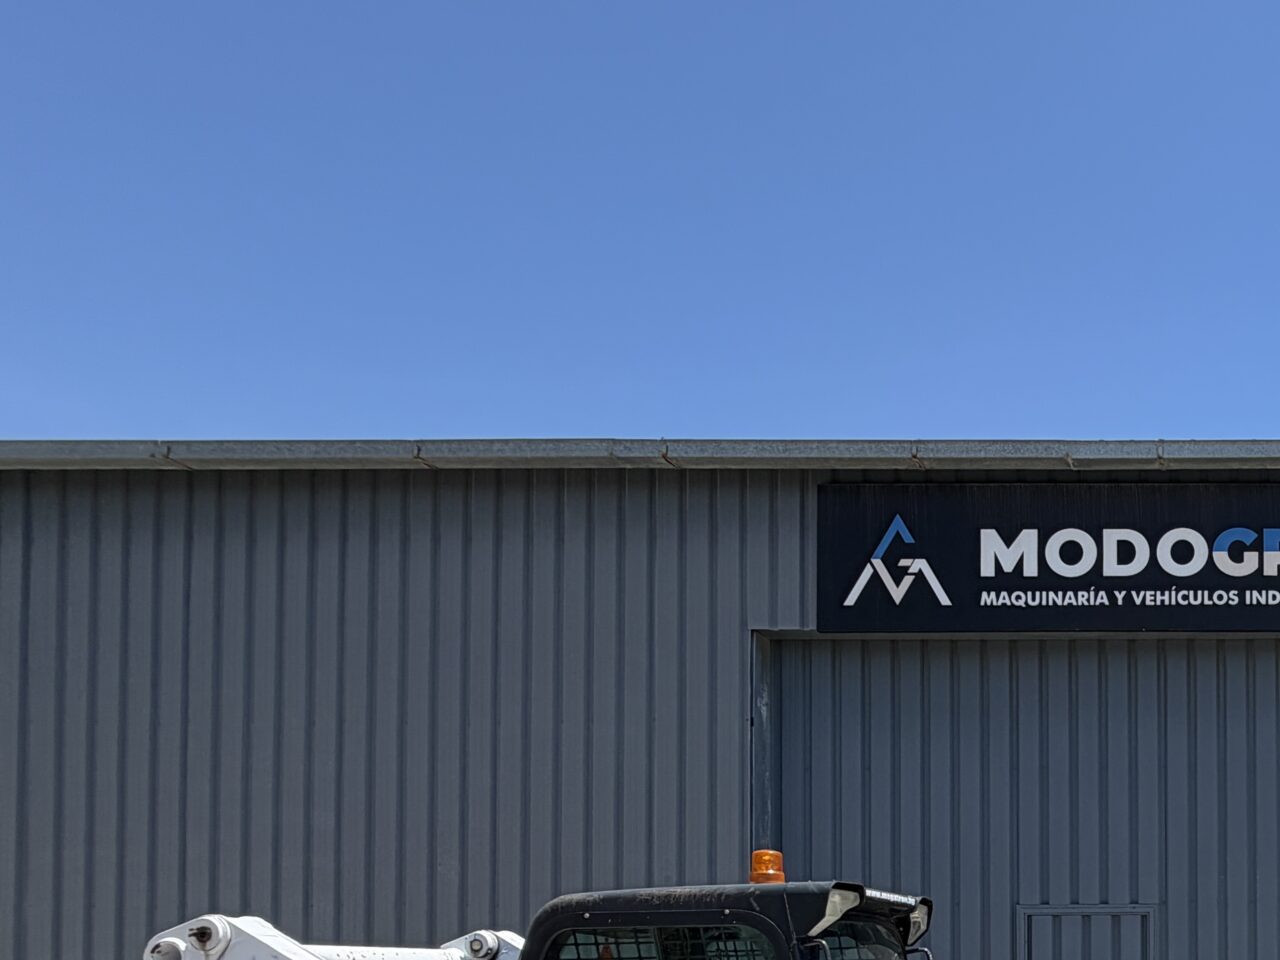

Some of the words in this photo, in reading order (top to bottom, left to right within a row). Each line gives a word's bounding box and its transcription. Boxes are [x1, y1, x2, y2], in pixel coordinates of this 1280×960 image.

[979, 586, 1110, 608] MAQUINARÍA
[1113, 590, 1127, 606] Y
[1130, 585, 1239, 606] VEHÍCULOS
